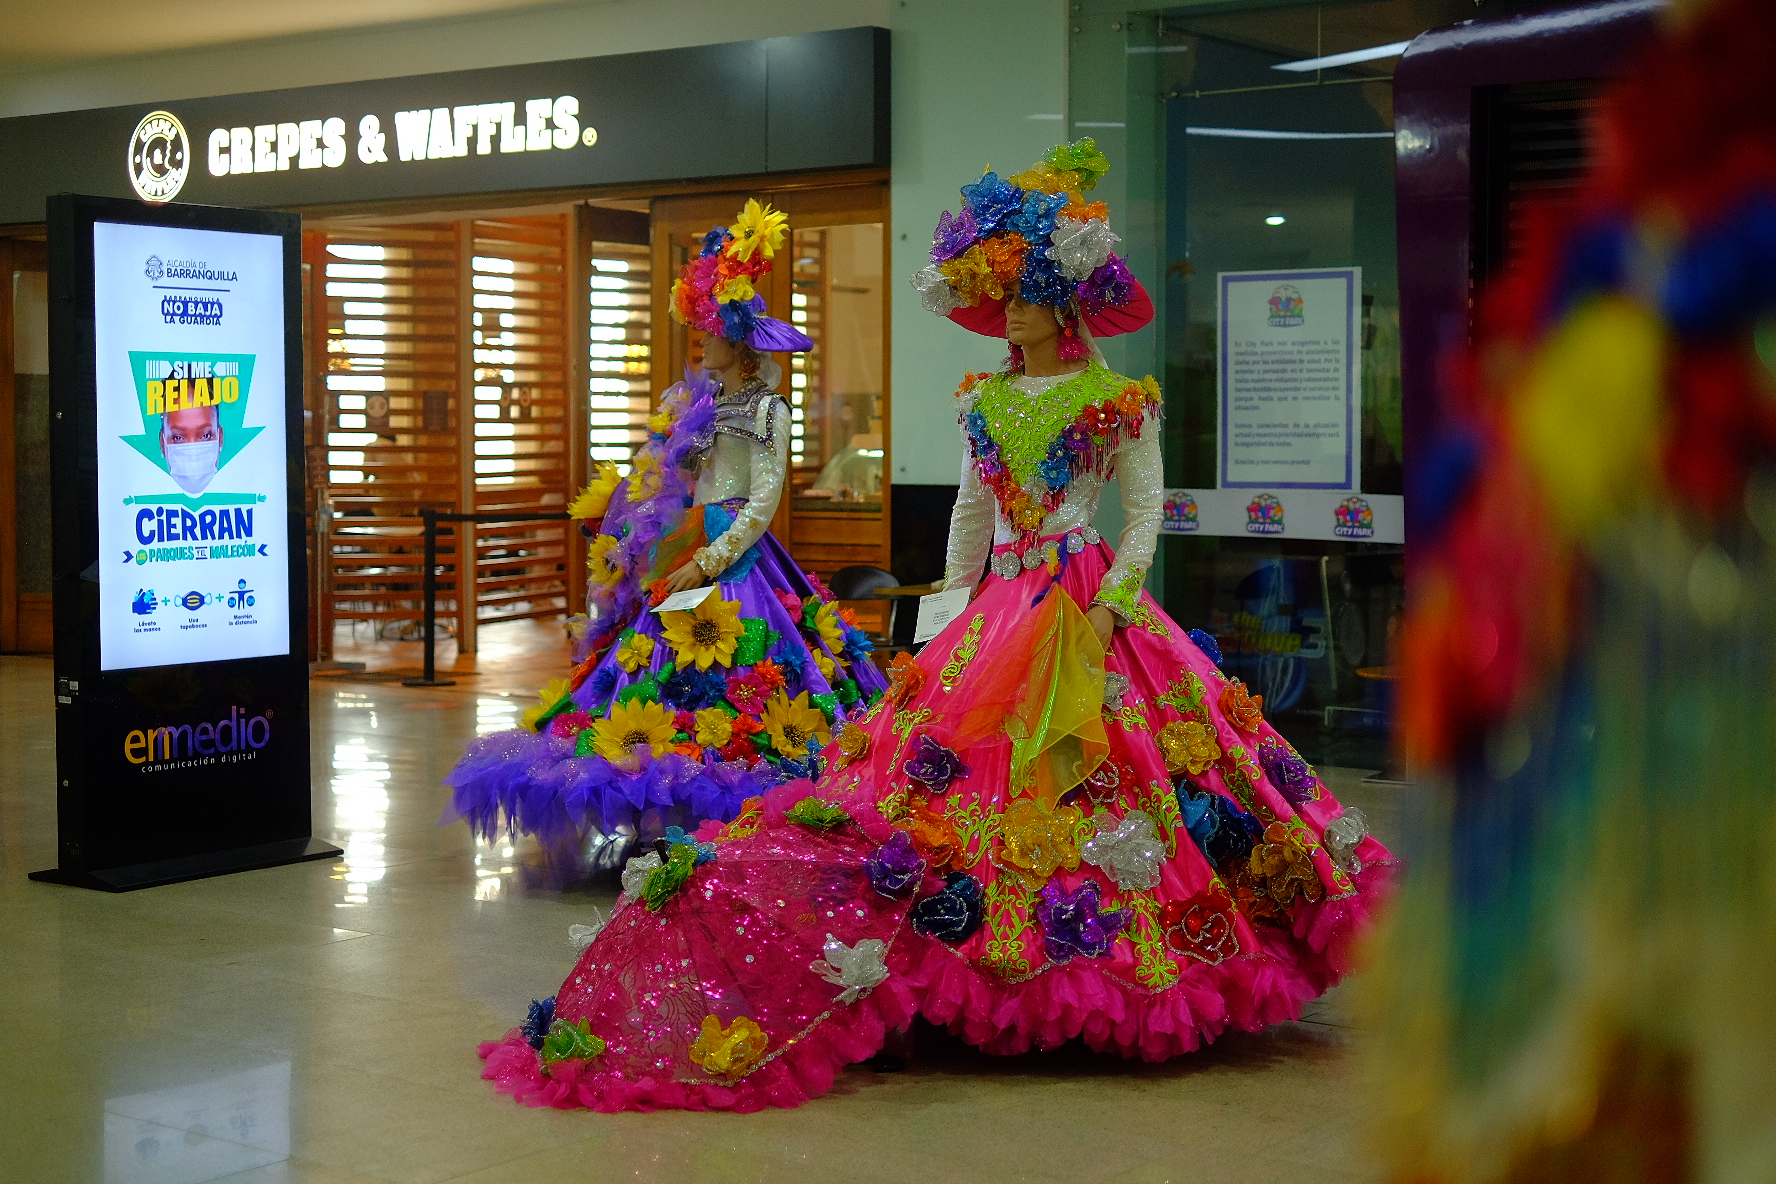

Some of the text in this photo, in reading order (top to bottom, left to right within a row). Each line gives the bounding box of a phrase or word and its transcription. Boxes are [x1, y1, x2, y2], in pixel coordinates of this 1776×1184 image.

[208, 117, 346, 177] CREPES
[358, 114, 388, 164] &
[166, 259, 207, 269] ALCALDÍA DE
[166, 268, 238, 282] BARRANQUILLA
[164, 301, 220, 316] NO BAJA
[164, 316, 221, 326] LA GUARDIA
[174, 361, 212, 379] SI ME
[147, 377, 239, 416] RELAJO
[1163, 521, 1198, 530] CITY PARK
[1247, 524, 1284, 532] CITY PARK
[1335, 527, 1373, 536] CITY PARK
[149, 546, 194, 562] PARQUES
[210, 540, 256, 559] MALECÓN
[142, 751, 256, 773] comunicación digital
